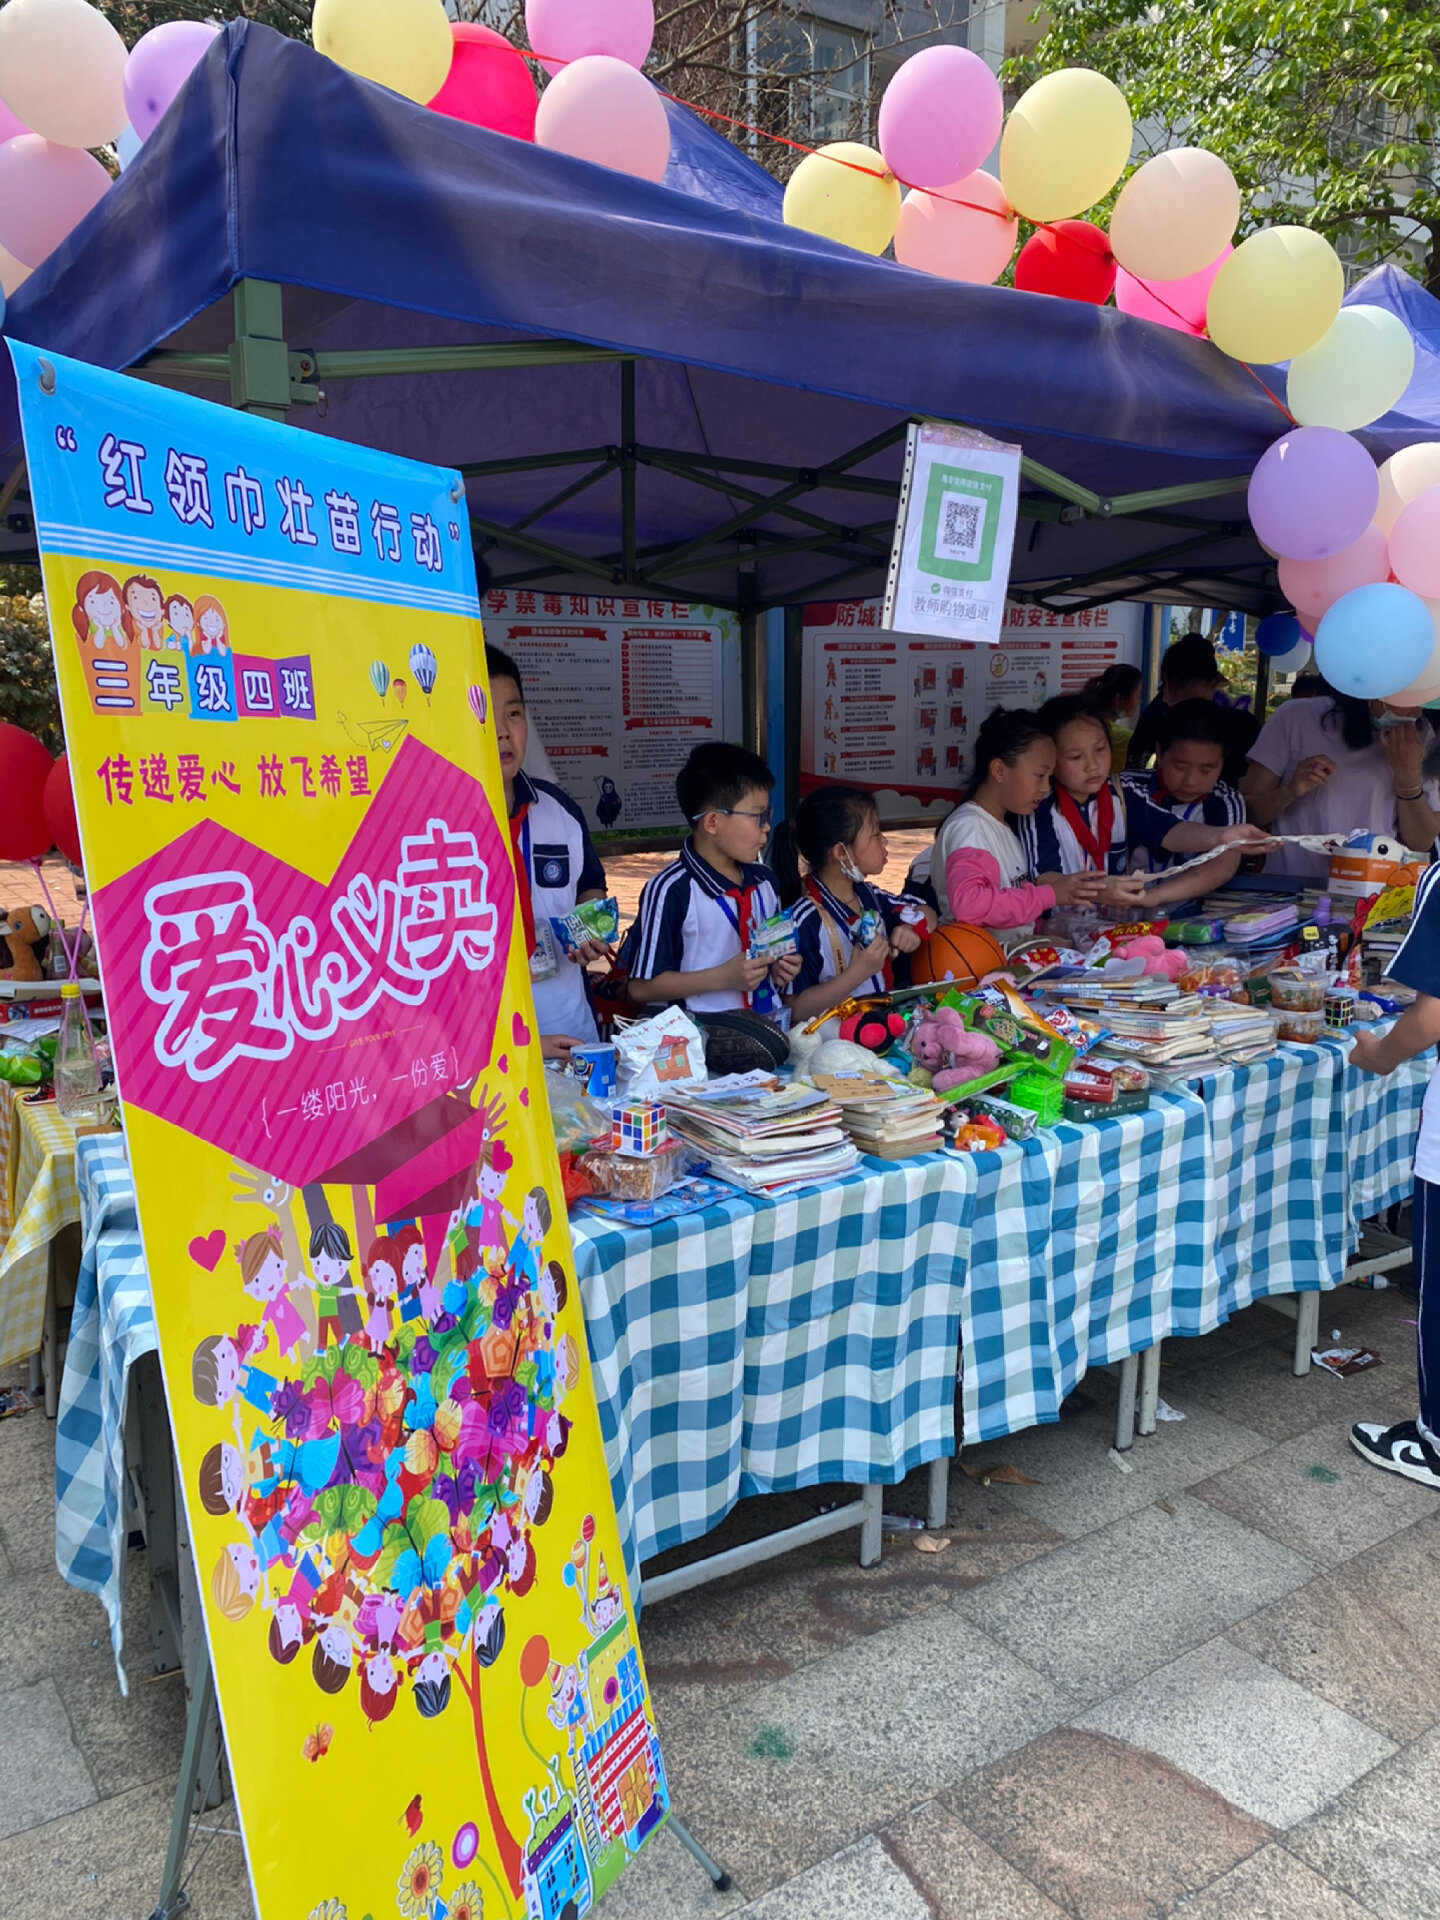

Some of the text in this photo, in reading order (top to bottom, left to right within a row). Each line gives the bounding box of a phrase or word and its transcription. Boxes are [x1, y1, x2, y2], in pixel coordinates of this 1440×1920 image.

[55, 425, 460, 571] “红领巾壮苗行动”
[914, 595, 990, 621] 教师购物通道
[93, 659, 313, 713] 三年级四班
[97, 752, 373, 806] 传递爱心 放飞希望
[141, 818, 498, 1082] 爱心义卖
